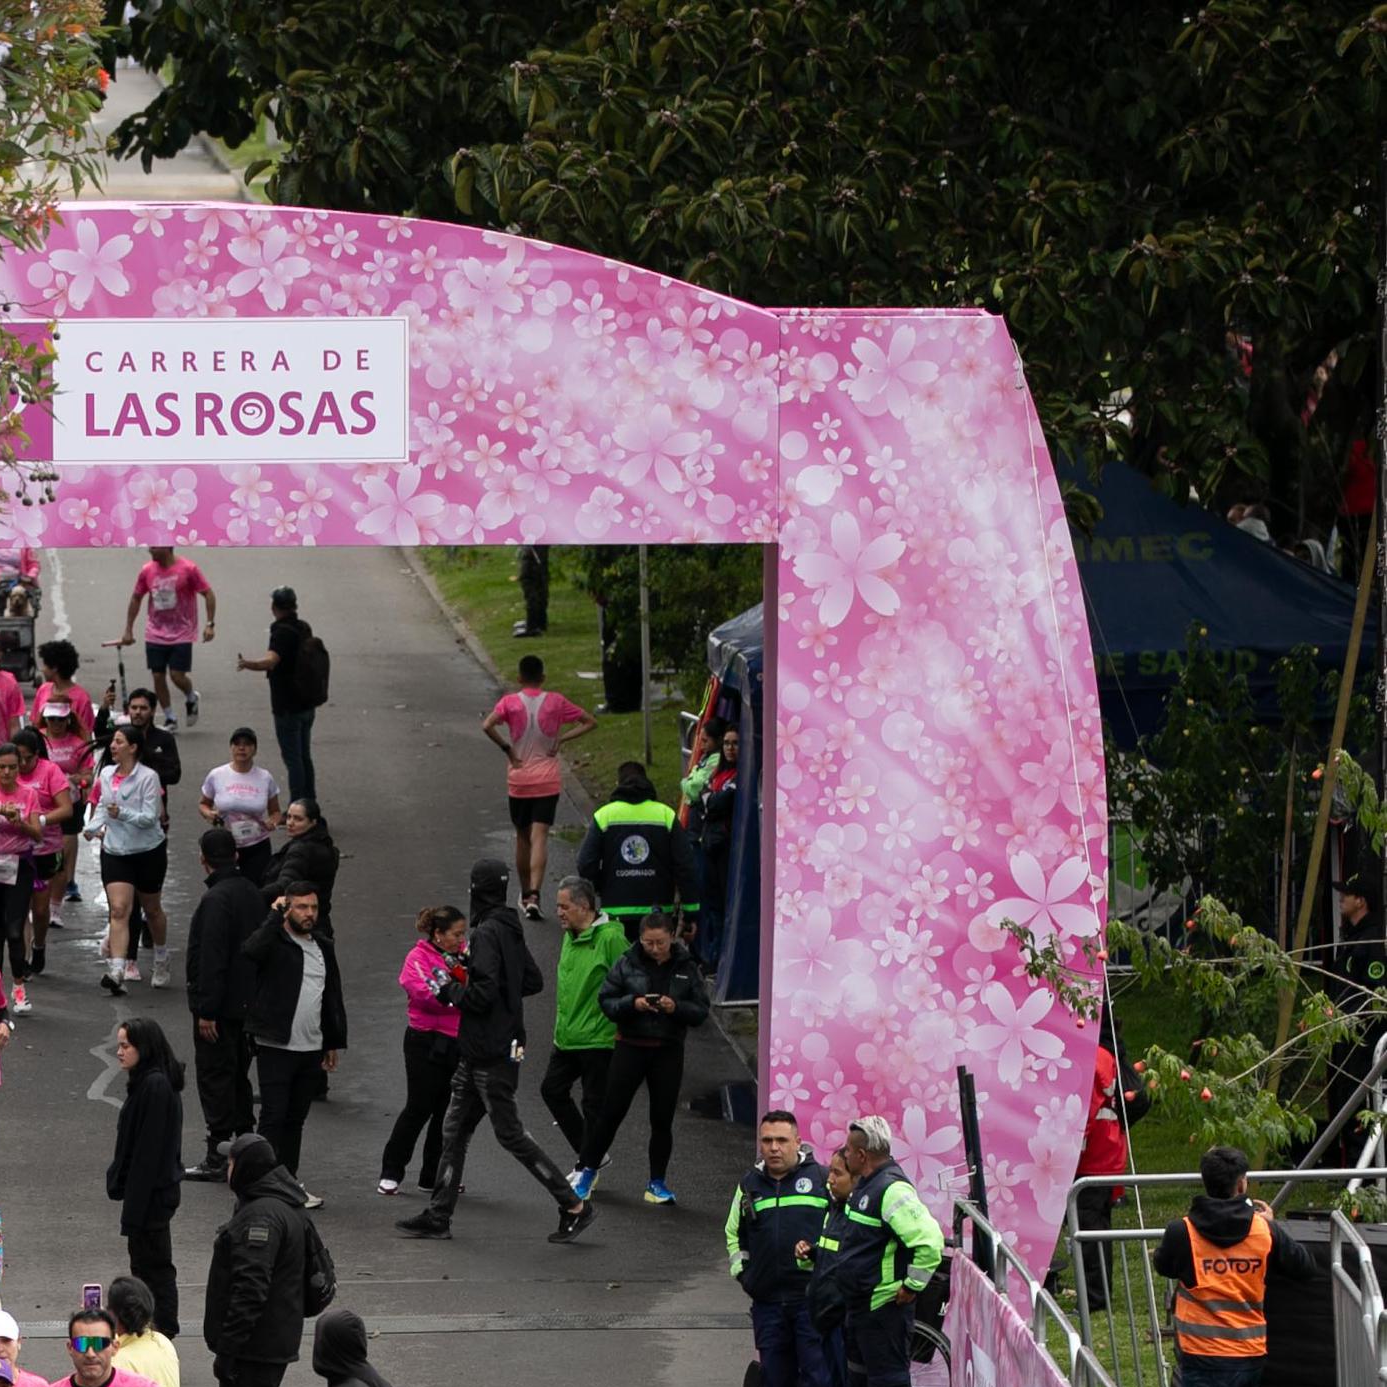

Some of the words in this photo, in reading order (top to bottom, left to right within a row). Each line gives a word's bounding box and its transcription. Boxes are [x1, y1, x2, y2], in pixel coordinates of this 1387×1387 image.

[85, 350, 290, 372] CARRERA
[323, 349, 370, 371] DE
[85, 392, 181, 436] LAS
[195, 391, 376, 436] ROSAS
